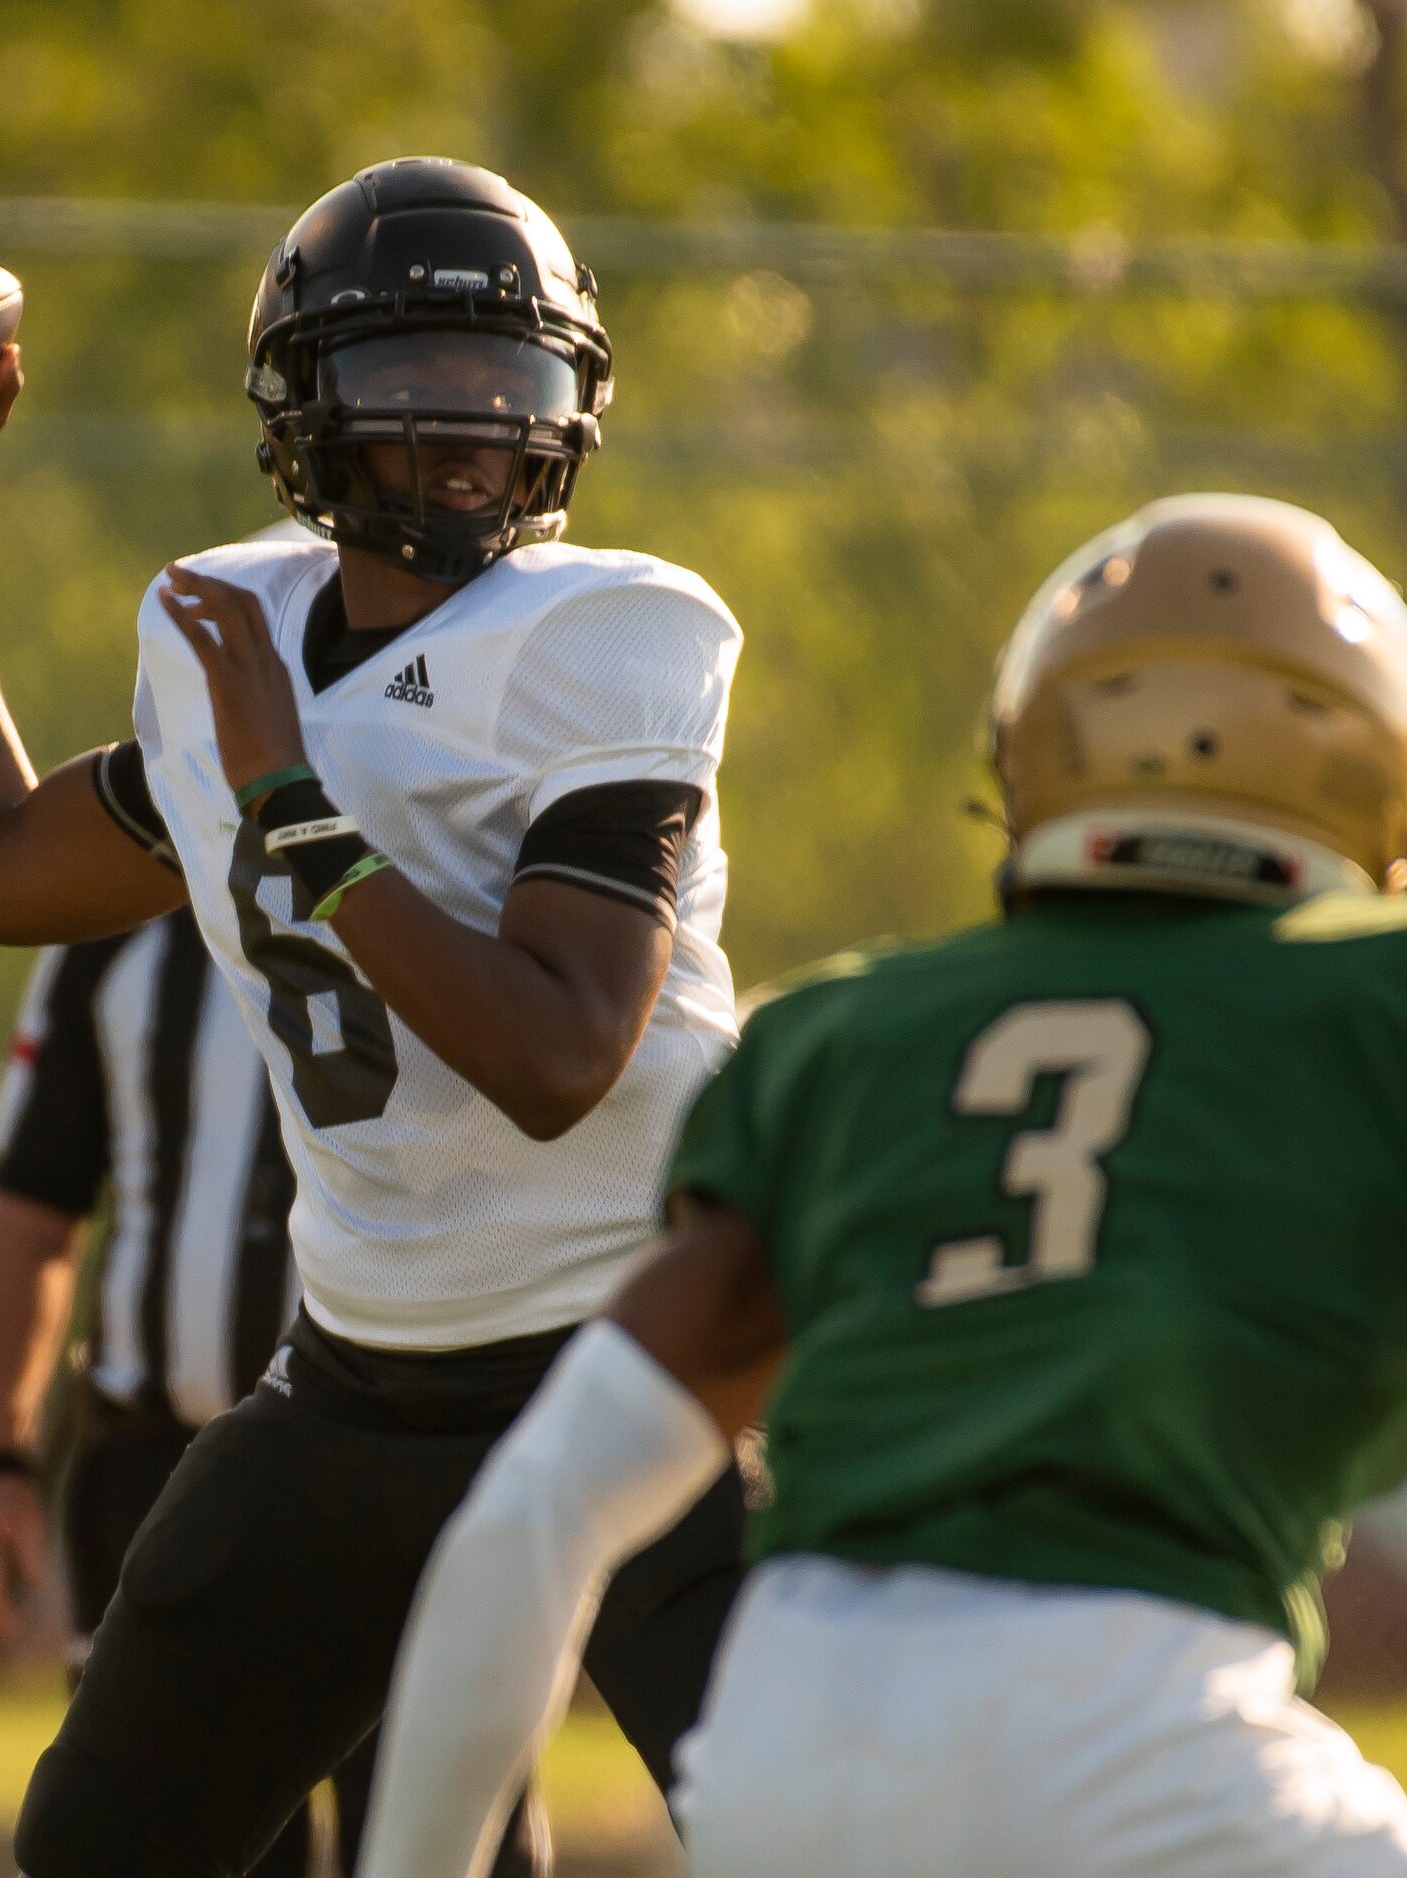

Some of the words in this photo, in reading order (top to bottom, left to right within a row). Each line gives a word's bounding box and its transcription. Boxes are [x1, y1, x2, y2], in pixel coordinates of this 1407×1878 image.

[384, 681, 434, 708] adidas
[227, 818, 399, 1129] 6
[914, 996, 1153, 1310] 3
